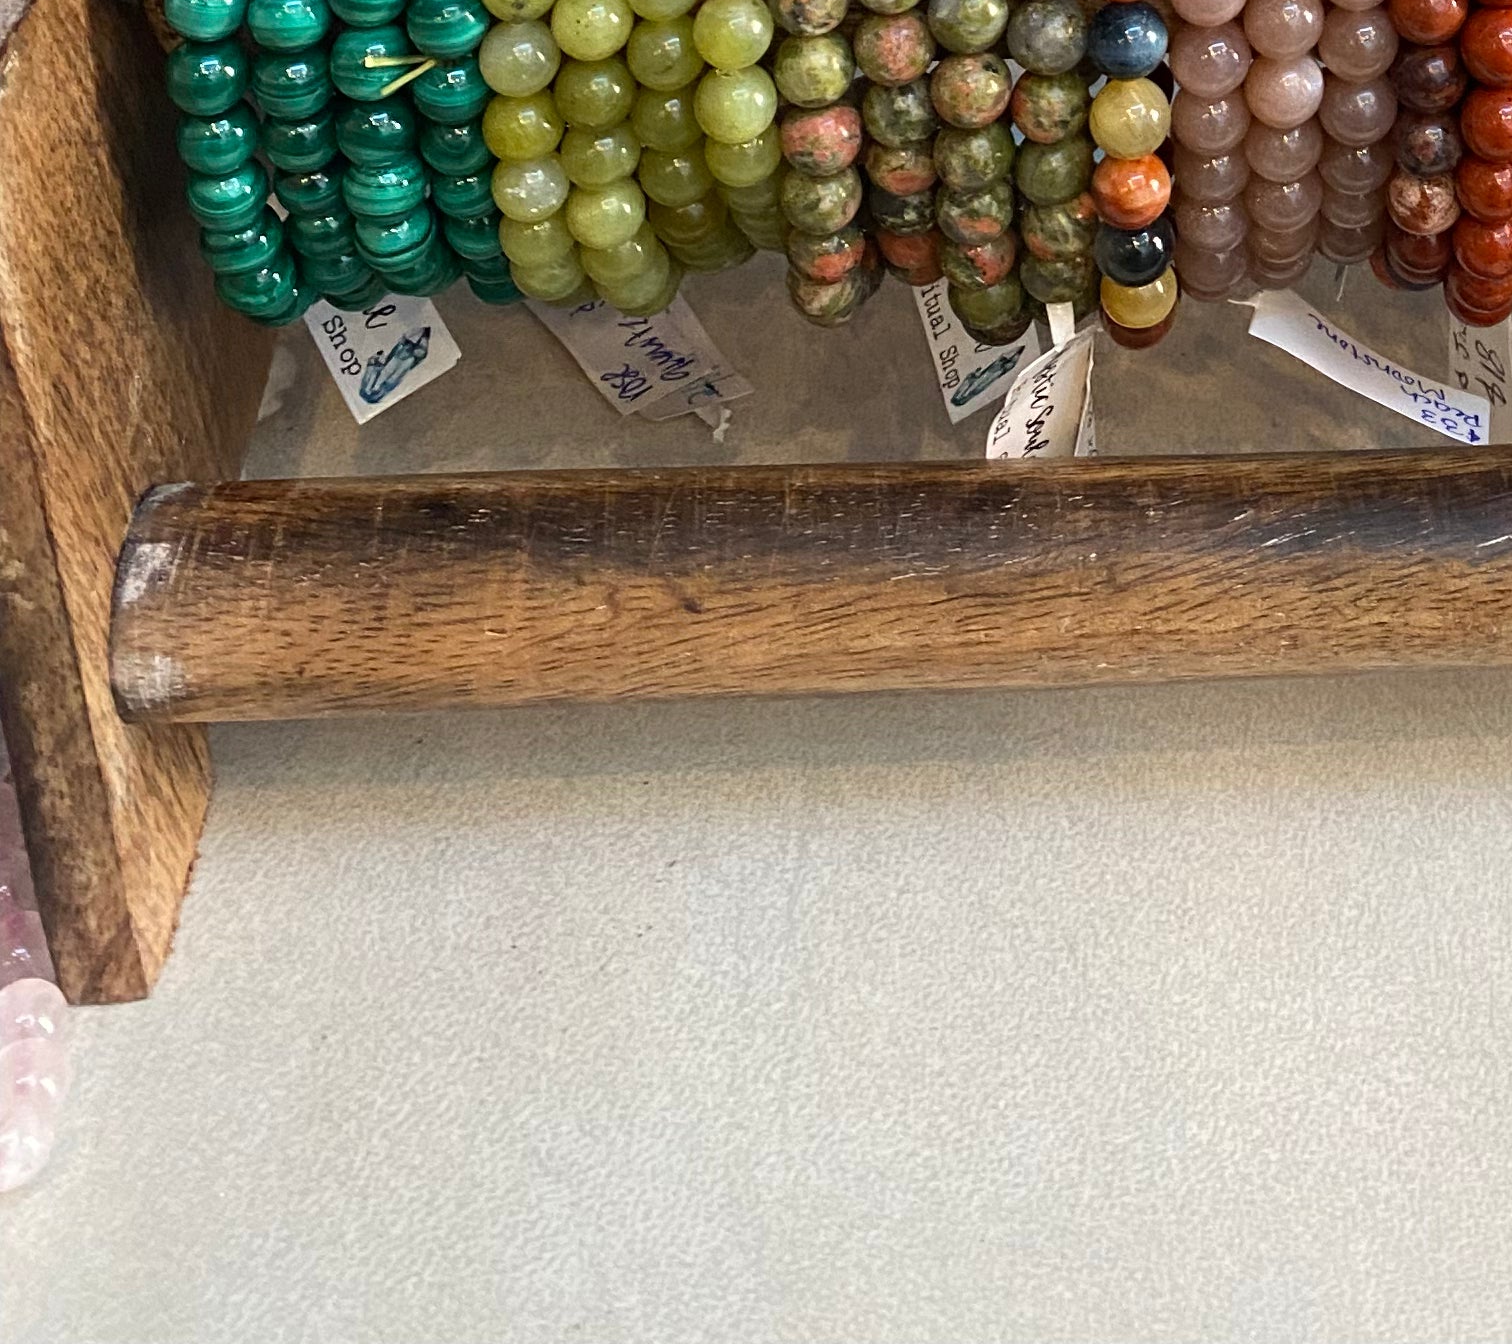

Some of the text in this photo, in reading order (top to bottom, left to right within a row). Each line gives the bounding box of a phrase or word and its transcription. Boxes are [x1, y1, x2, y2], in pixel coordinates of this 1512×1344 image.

[321, 315, 362, 376] Shop
[921, 281, 961, 389] itual Shop
